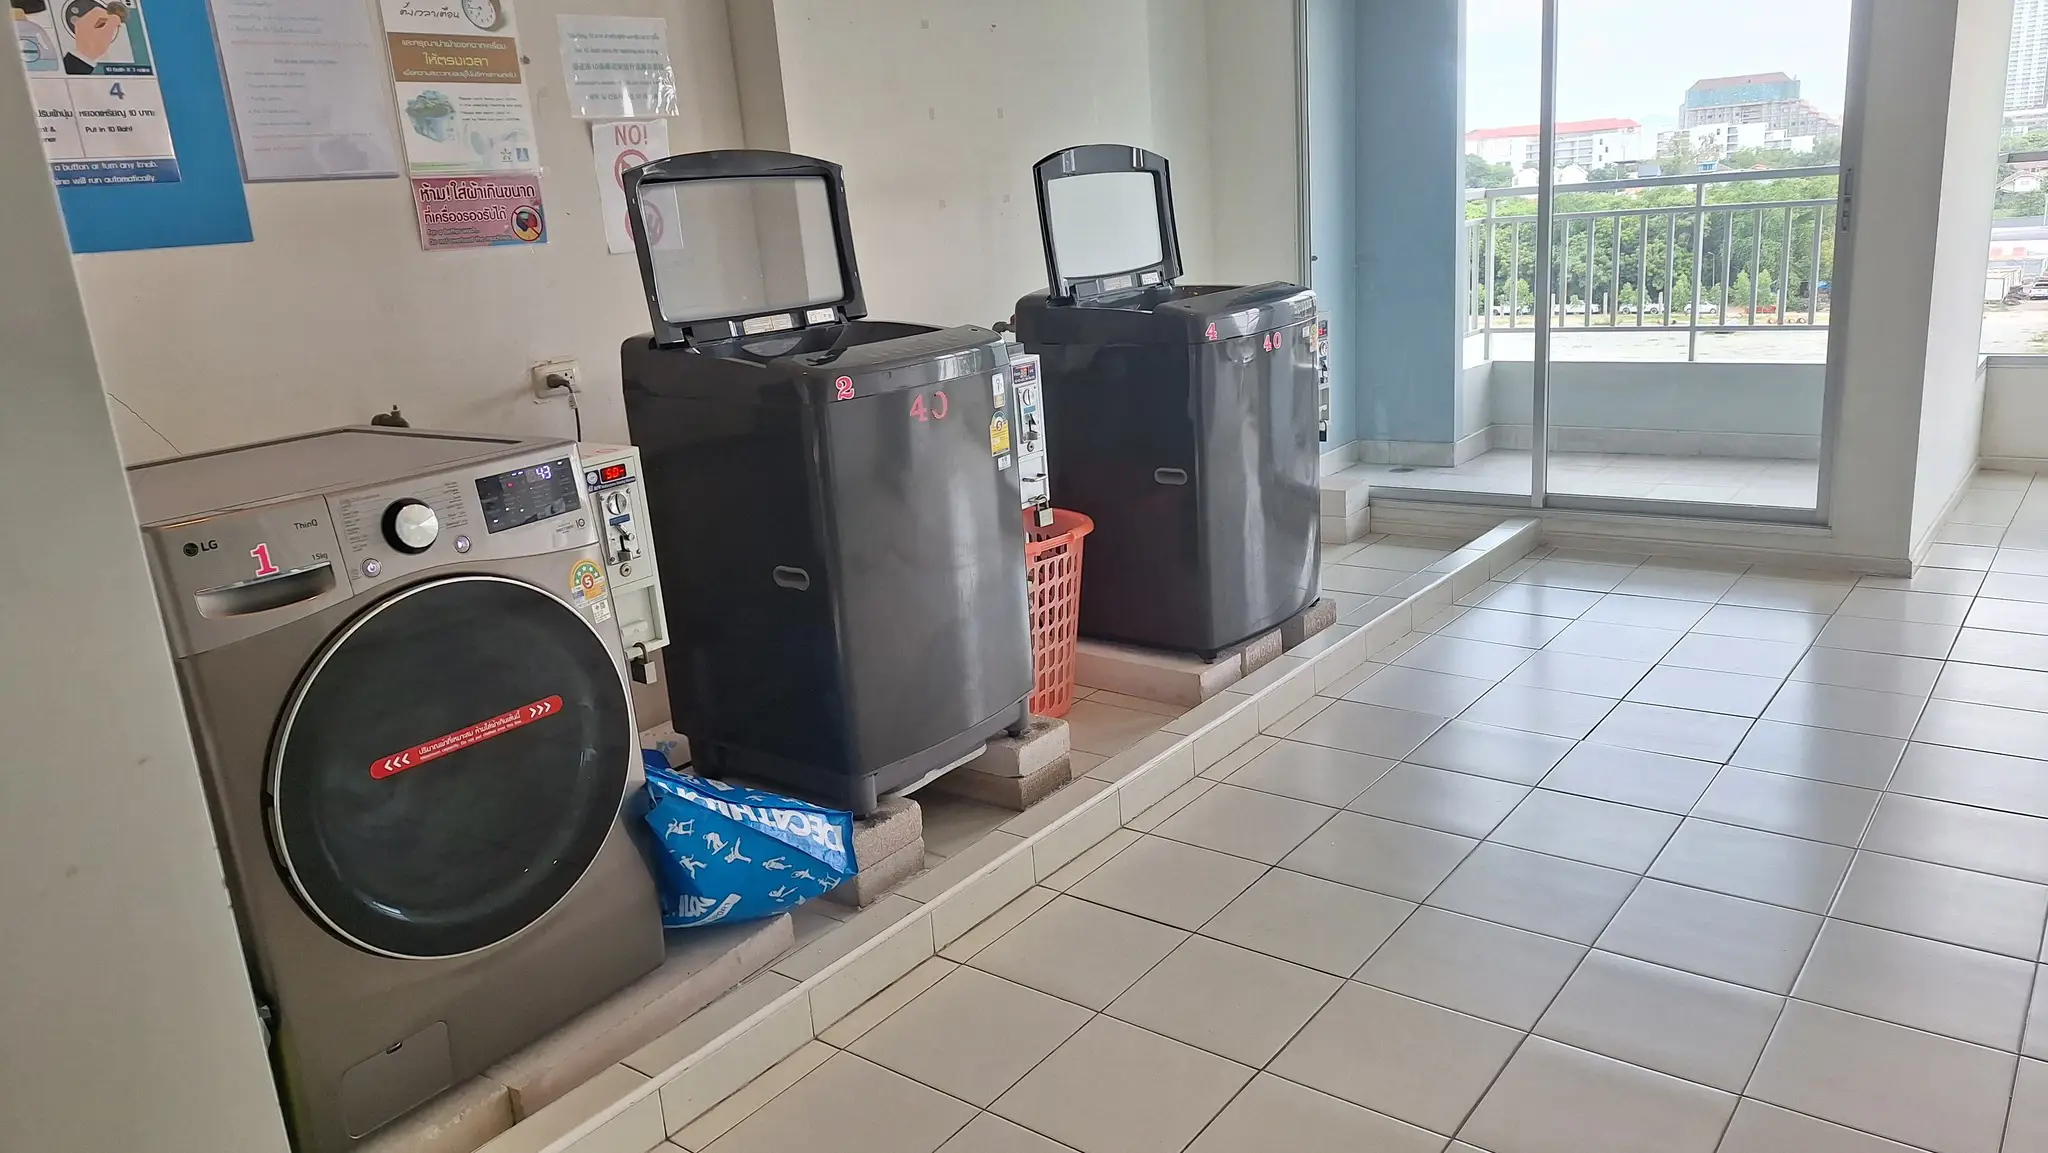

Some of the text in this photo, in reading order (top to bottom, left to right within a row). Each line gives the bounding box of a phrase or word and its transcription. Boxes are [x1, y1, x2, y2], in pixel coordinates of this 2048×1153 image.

[422, 52, 488, 67] ให้ตรงเวลา
[109, 82, 126, 100] 4
[117, 125, 133, 133] Baht
[614, 124, 648, 146] NO!
[62, 162, 89, 171] button
[120, 162, 134, 171] any
[72, 175, 86, 184] will
[88, 176, 102, 184] run
[104, 173, 157, 184] automatically.
[424, 205, 507, 224] ที่เครื่องรองรับได้
[1205, 322, 1218, 341] 4
[1263, 331, 1282, 352] 40
[836, 376, 854, 401] 2
[536, 465, 552, 480] 43
[293, 518, 318, 531] ThinQ
[200, 540, 218, 552] LG
[250, 542, 279, 577] 1
[584, 576, 592, 588] 5
